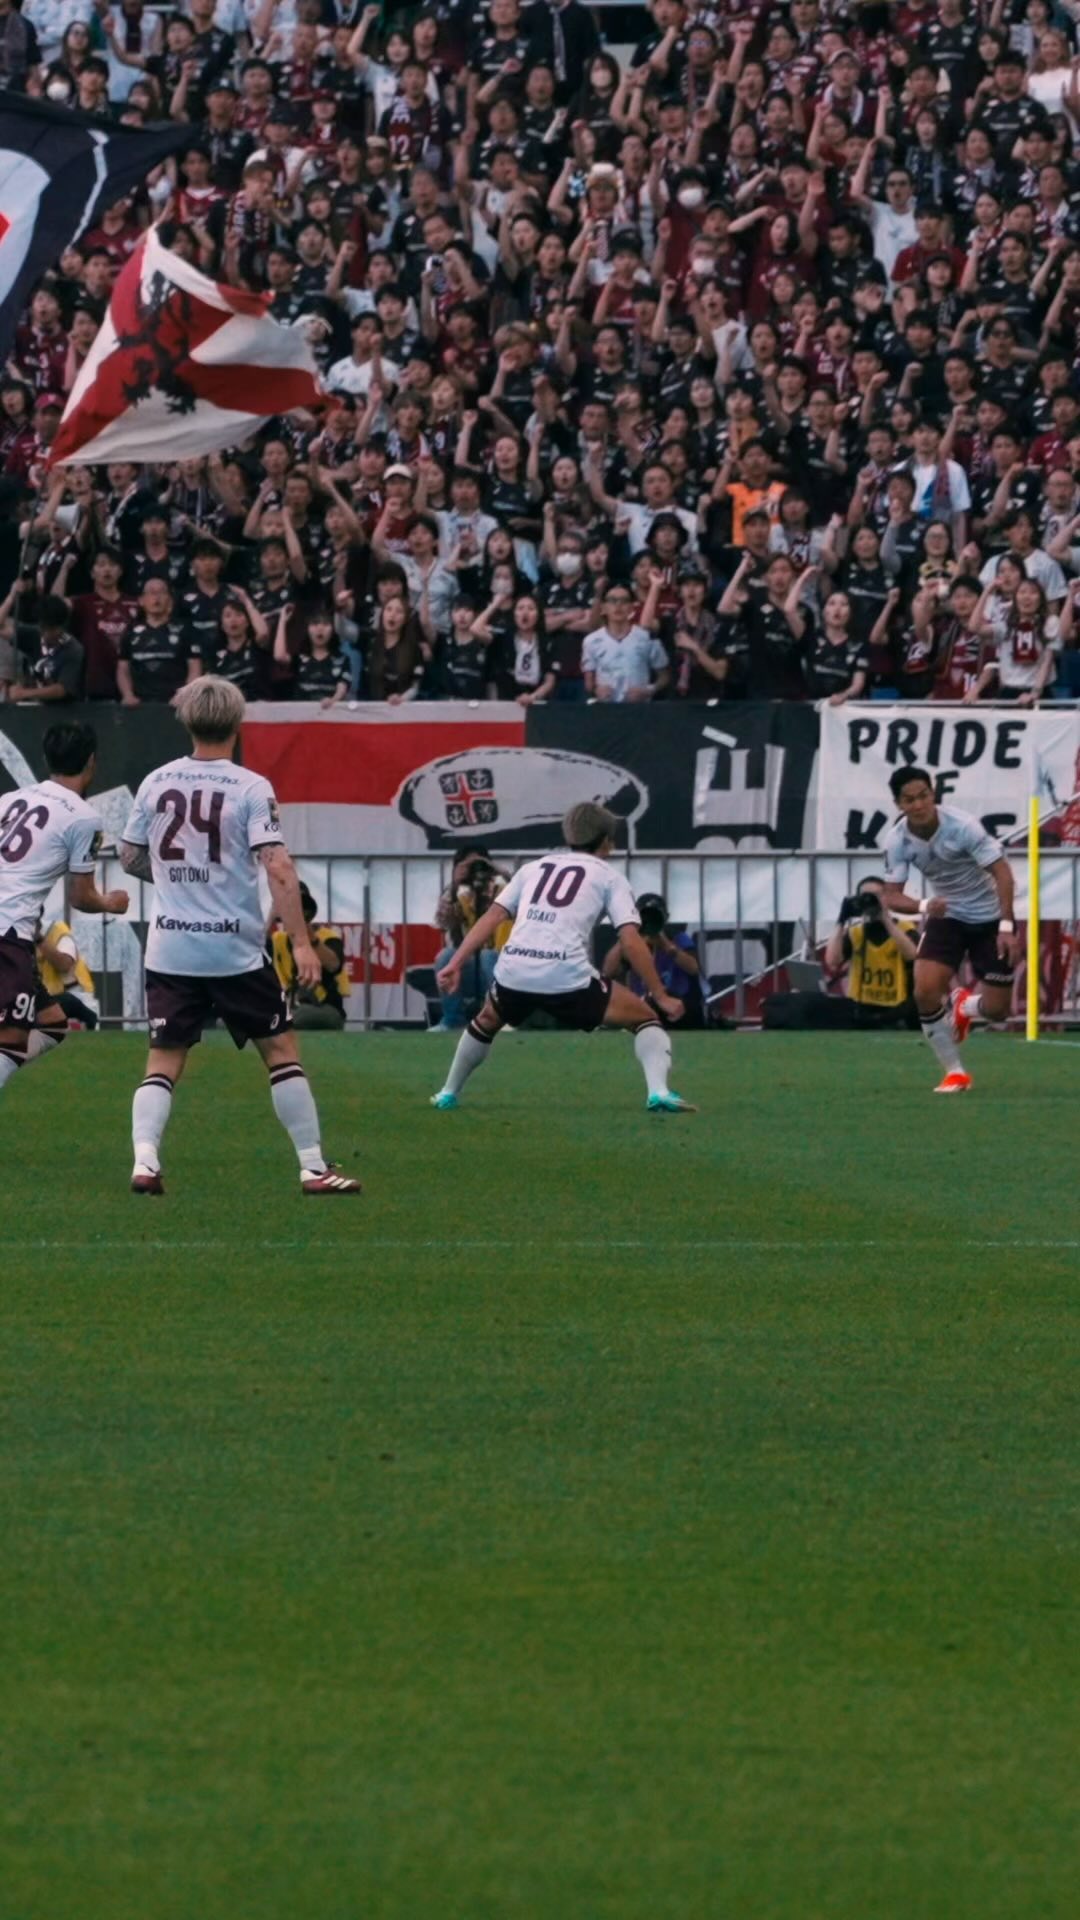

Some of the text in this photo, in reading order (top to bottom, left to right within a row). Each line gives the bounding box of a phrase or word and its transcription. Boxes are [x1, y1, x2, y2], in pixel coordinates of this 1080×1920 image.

[848, 718, 1027, 769] PRIDE
[156, 788, 225, 864] 24
[169, 866, 210, 883] GOTOKU
[530, 862, 586, 908] 10
[155, 914, 241, 934] Kawasaki
[526, 908, 557, 923] OSAKO
[503, 945, 567, 960] Kawasaki
